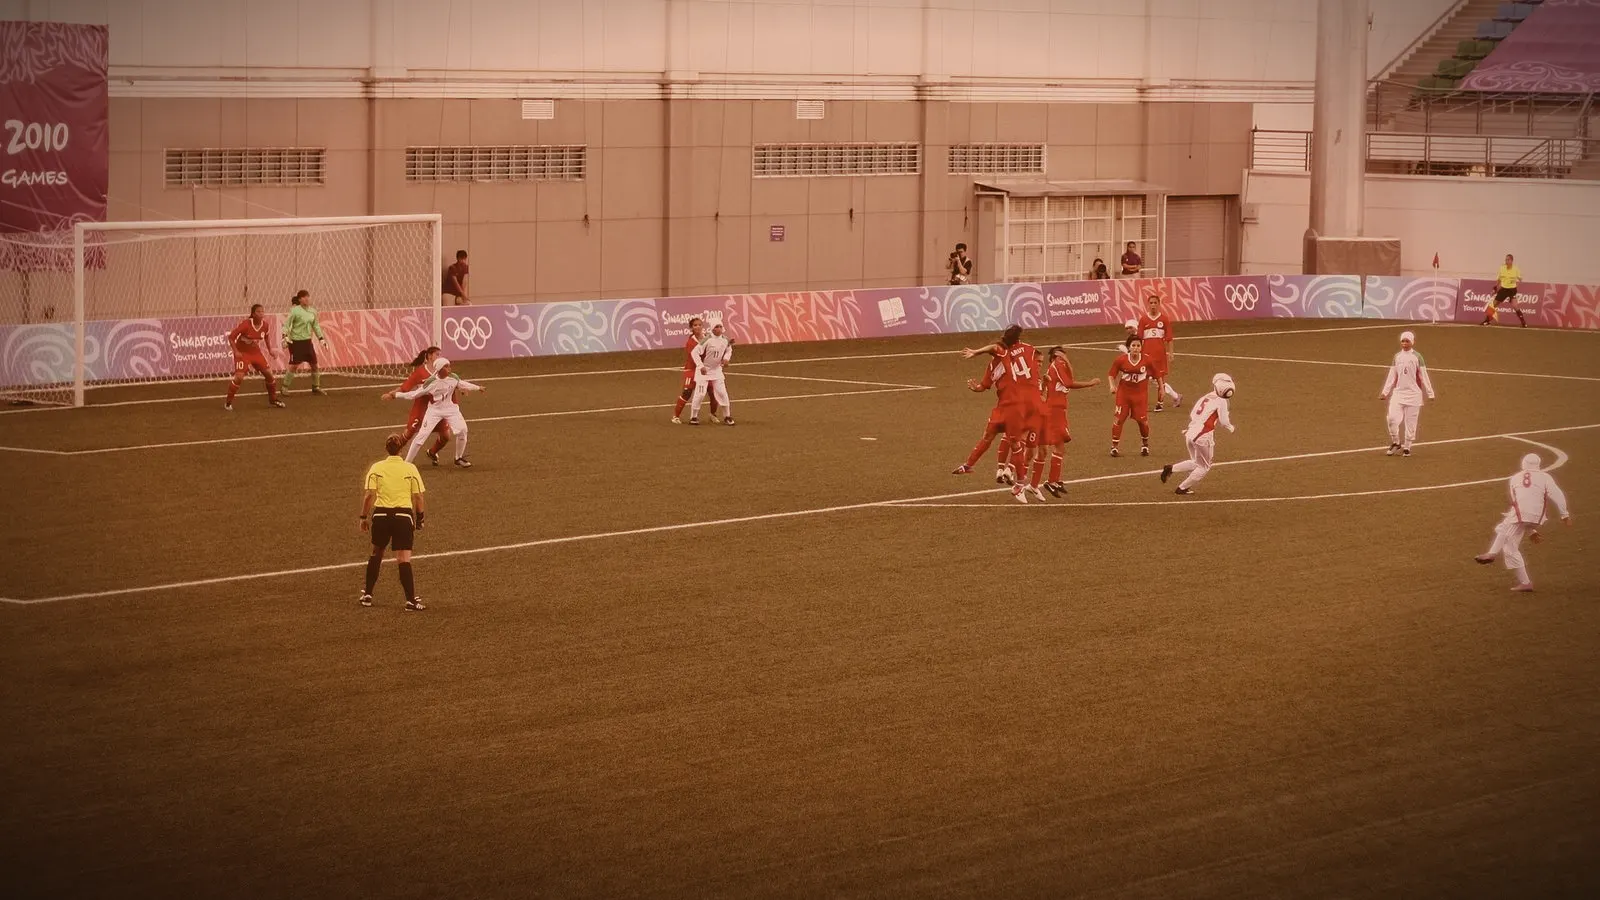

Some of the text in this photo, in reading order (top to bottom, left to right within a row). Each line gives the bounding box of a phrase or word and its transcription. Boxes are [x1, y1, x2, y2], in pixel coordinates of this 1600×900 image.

[5, 119, 69, 155] 2010
[2, 168, 68, 189] GAMES
[1082, 292, 1099, 304] 2010
[1516, 293, 1539, 304] 2010
[236, 361, 244, 370] 10
[1010, 356, 1031, 382] 14
[1196, 397, 1209, 416] 5
[411, 418, 419, 428] 2
[1029, 432, 1037, 442] 8
[1522, 472, 1532, 489] 8
